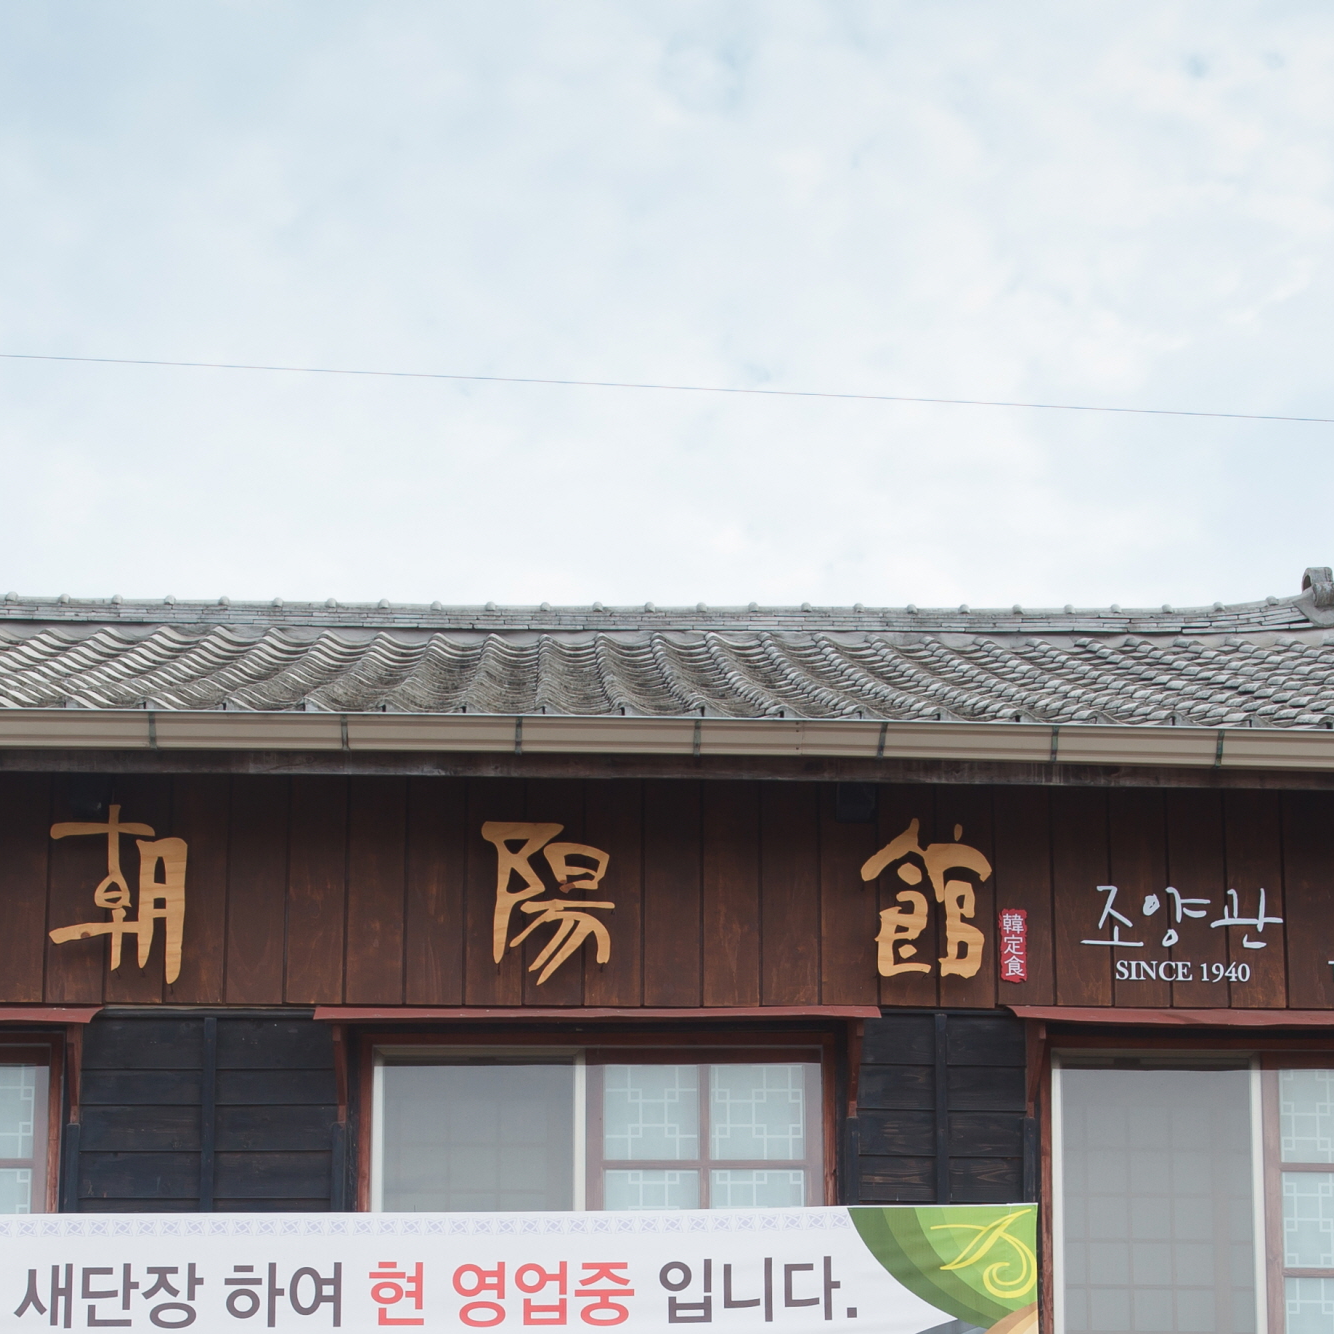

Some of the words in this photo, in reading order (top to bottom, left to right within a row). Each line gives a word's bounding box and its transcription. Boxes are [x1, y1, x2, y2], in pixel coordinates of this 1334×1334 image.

[1002, 913, 1025, 977] 韓定食
[1080, 885, 1284, 949] 조양관
[1115, 959, 1193, 982] SINCE
[1200, 960, 1251, 983] 1940
[13, 1261, 205, 1330] 새단장
[224, 1260, 343, 1329] 하여
[368, 1260, 425, 1327] 현
[452, 1259, 636, 1328] 영업중
[658, 1255, 859, 1324] 입니다.
